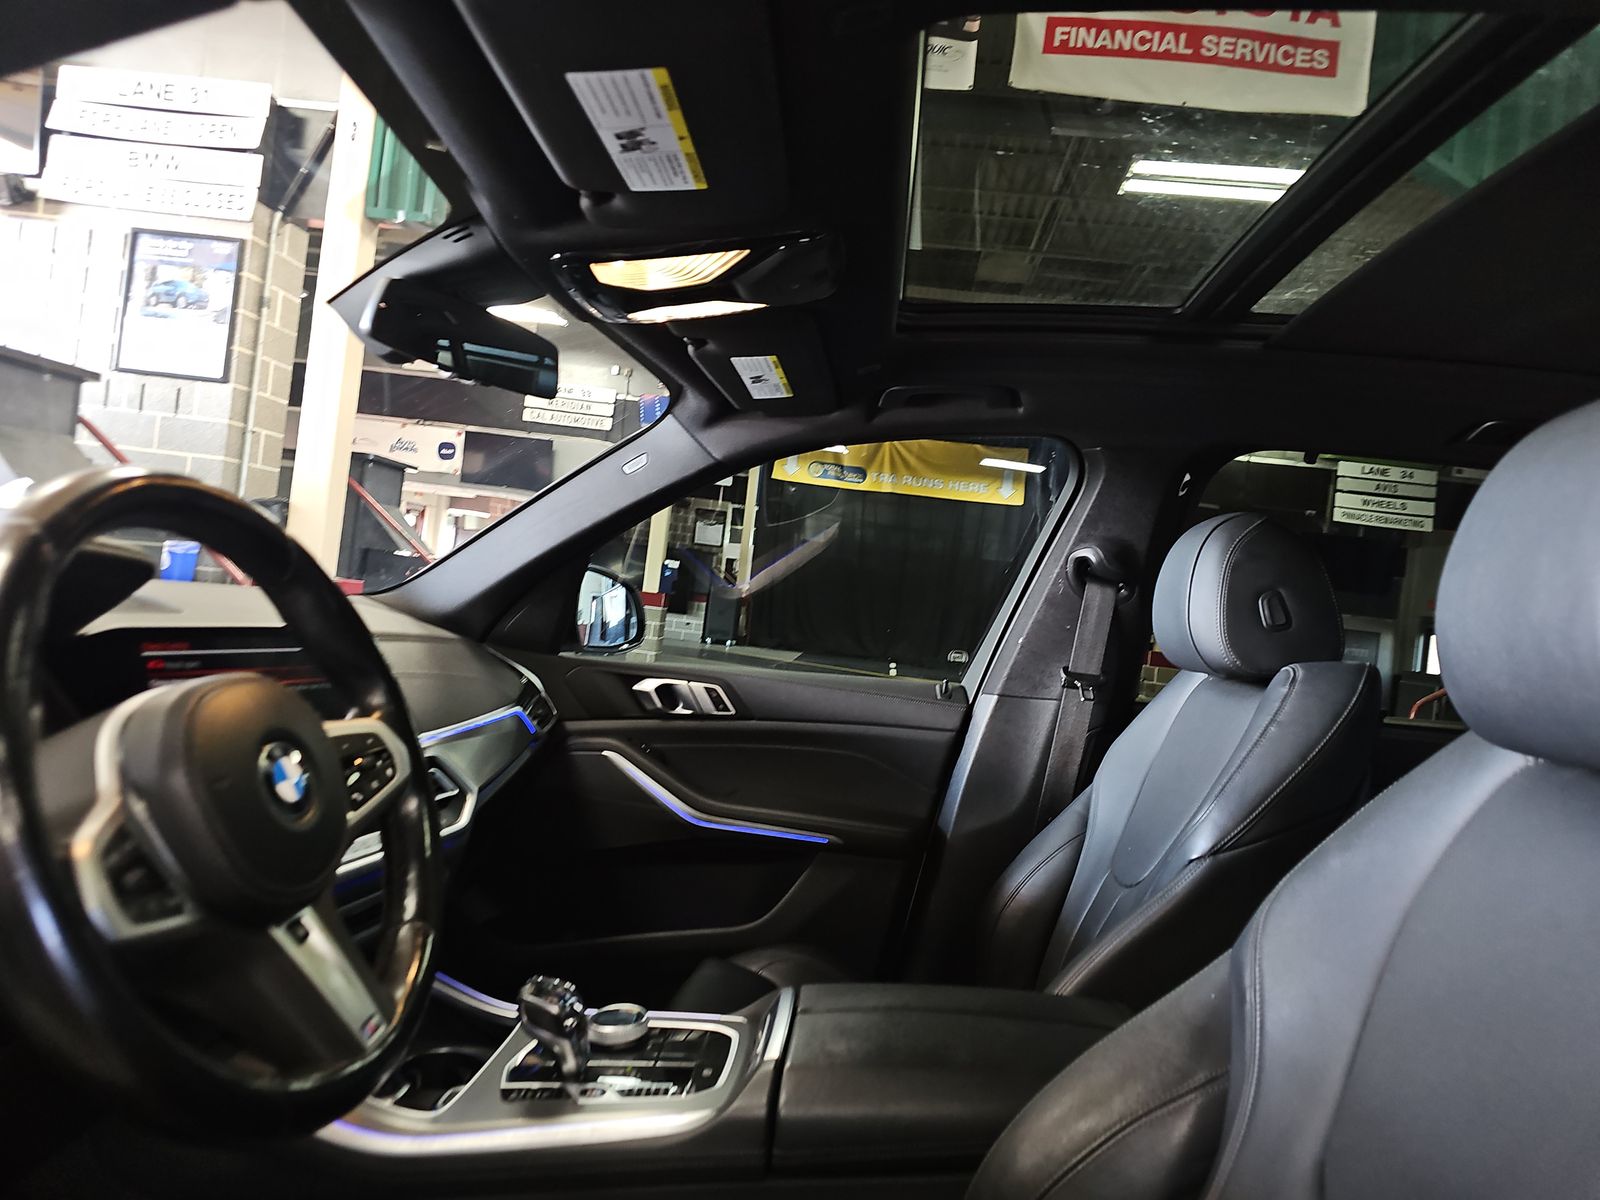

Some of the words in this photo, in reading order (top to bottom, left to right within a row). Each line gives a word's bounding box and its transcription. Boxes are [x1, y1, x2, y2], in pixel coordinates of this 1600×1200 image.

[1052, 26, 1194, 56] FINANCIAL
[1199, 33, 1331, 70] SERVICES
[118, 80, 175, 102] LANE
[549, 411, 606, 428] AUTOMOTIVE
[1360, 464, 1391, 478] LANE
[870, 471, 897, 486] TRA
[902, 474, 945, 490] RUNS
[948, 479, 989, 494] HERE
[1374, 482, 1400, 494] AVIS
[1360, 497, 1409, 511] WHEELS
